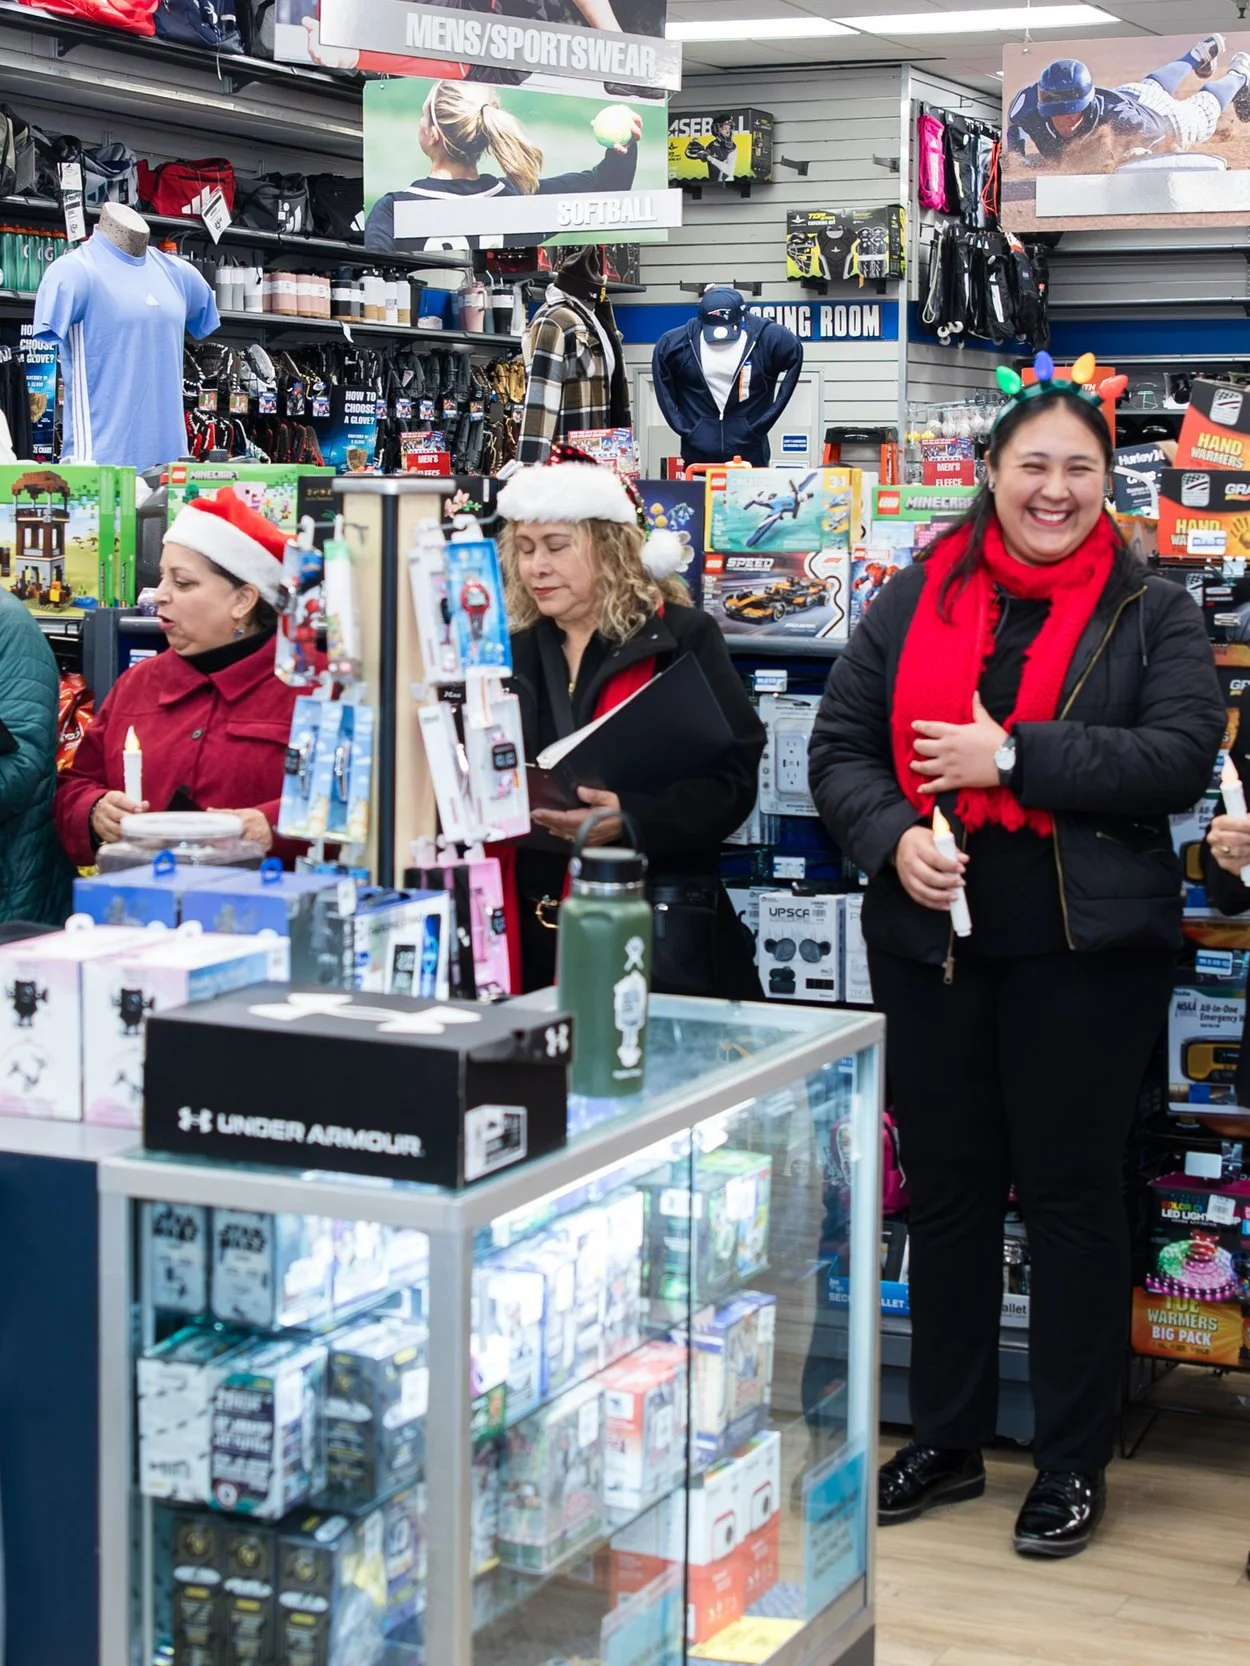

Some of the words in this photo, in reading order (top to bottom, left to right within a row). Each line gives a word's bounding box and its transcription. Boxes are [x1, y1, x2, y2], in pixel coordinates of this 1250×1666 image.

[405, 12, 656, 78] MENS/SPORTSWEAR
[557, 195, 657, 227] SOFTBALL
[820, 305, 879, 336] ROOM
[20, 324, 33, 336] HO
[26, 354, 55, 363] GLOVE?
[345, 391, 365, 401] HOW
[366, 392, 376, 401] TO
[344, 403, 376, 414] CHOOSE
[344, 415, 350, 424] A
[350, 416, 375, 424] GLOVE?
[1197, 432, 1244, 455] HAND
[1118, 450, 1155, 466] Hurley
[1191, 446, 1245, 469] WARMERS
[936, 463, 961, 471] MEN'S
[190, 471, 240, 480] MINECRAFT
[935, 478, 963, 486] FLEECE
[905, 496, 975, 510] MINECRA
[1176, 519, 1221, 534] HAND
[726, 557, 775, 568] SPEED
[1200, 1004, 1238, 1014] All-in-One
[1200, 1013, 1238, 1023] Emergency
[217, 1113, 306, 1144] UNDER
[306, 1123, 422, 1157] ARMOUR
[1161, 1208, 1180, 1218] LED
[880, 1298, 905, 1309] LLET
[1166, 1296, 1200, 1312] TOE
[1148, 1309, 1218, 1331] WARMERS
[1152, 1326, 1175, 1341] BIG
[1178, 1330, 1212, 1346] PACK
